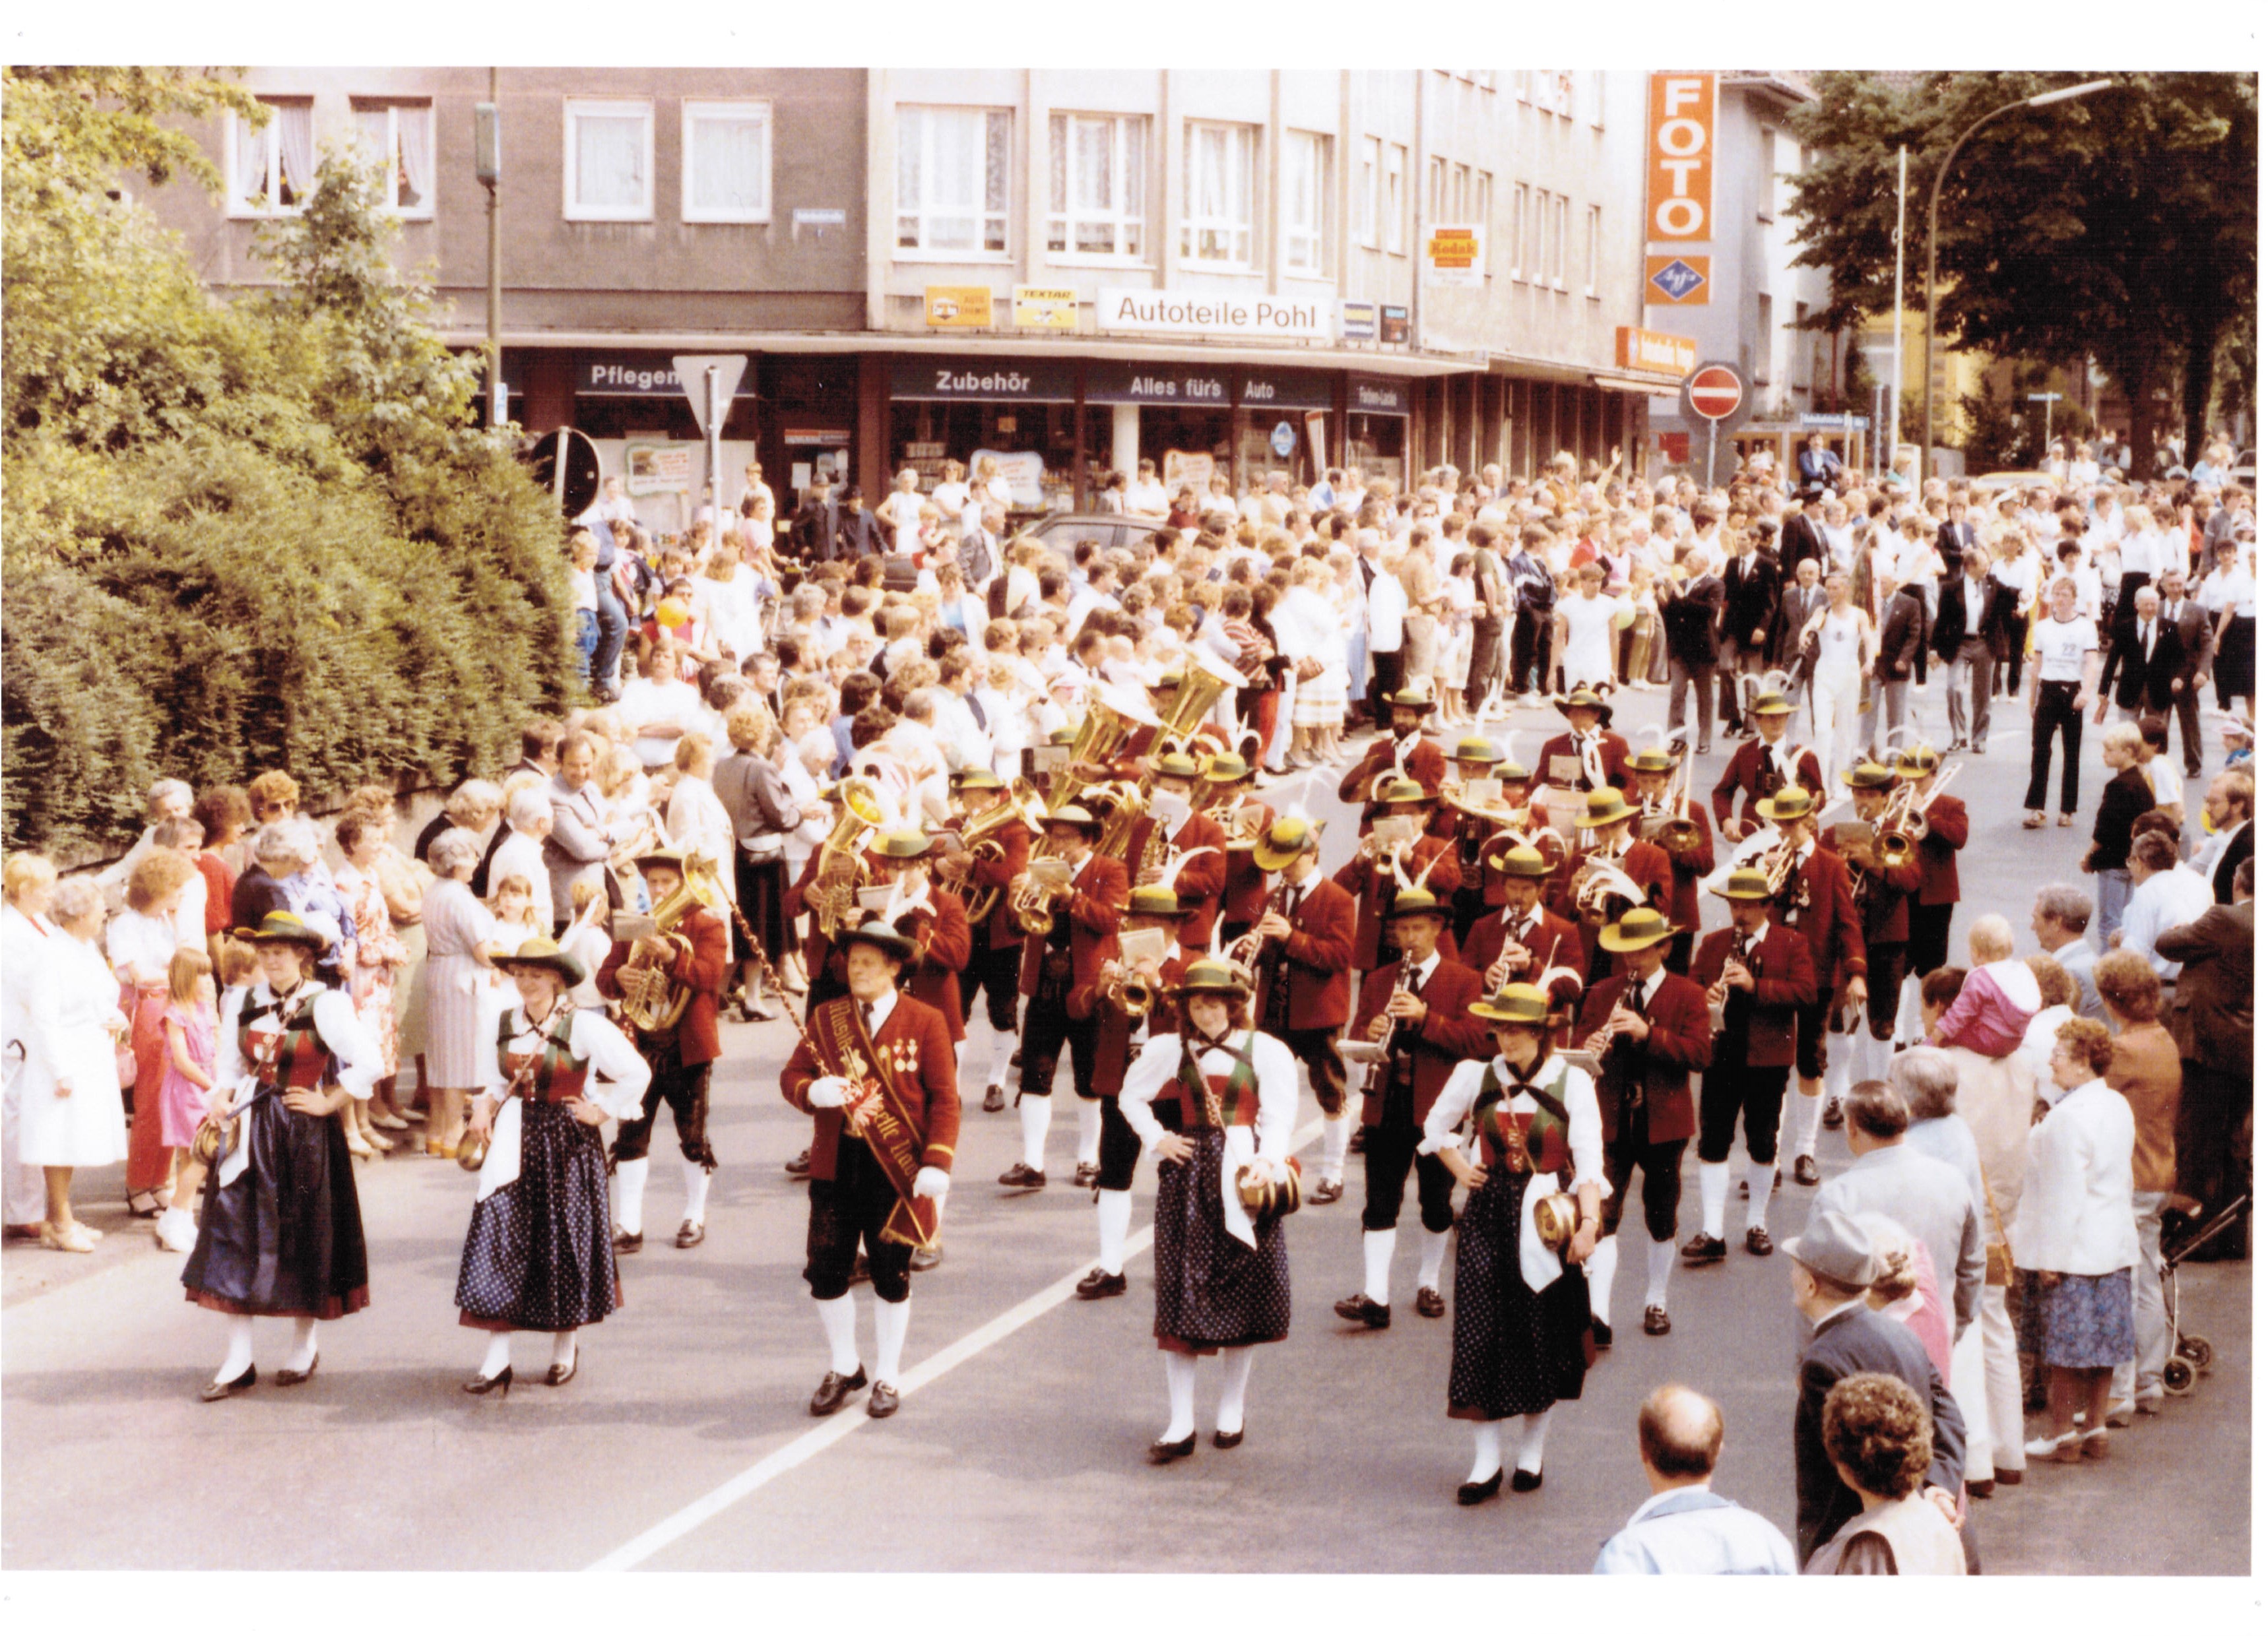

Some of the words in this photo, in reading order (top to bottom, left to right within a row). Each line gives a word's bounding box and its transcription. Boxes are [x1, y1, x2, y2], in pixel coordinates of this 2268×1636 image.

[1656, 79, 1706, 236] FOTO
[1431, 241, 1475, 255] Kodak
[1024, 290, 1071, 298] TEXTAR
[1118, 296, 1248, 326] Autoteile
[1256, 303, 1315, 328] Pohl
[936, 370, 1030, 391] Zubehör
[1130, 376, 1177, 395] Alles
[1245, 380, 1274, 398] Auto
[829, 999, 856, 1051] Musik
